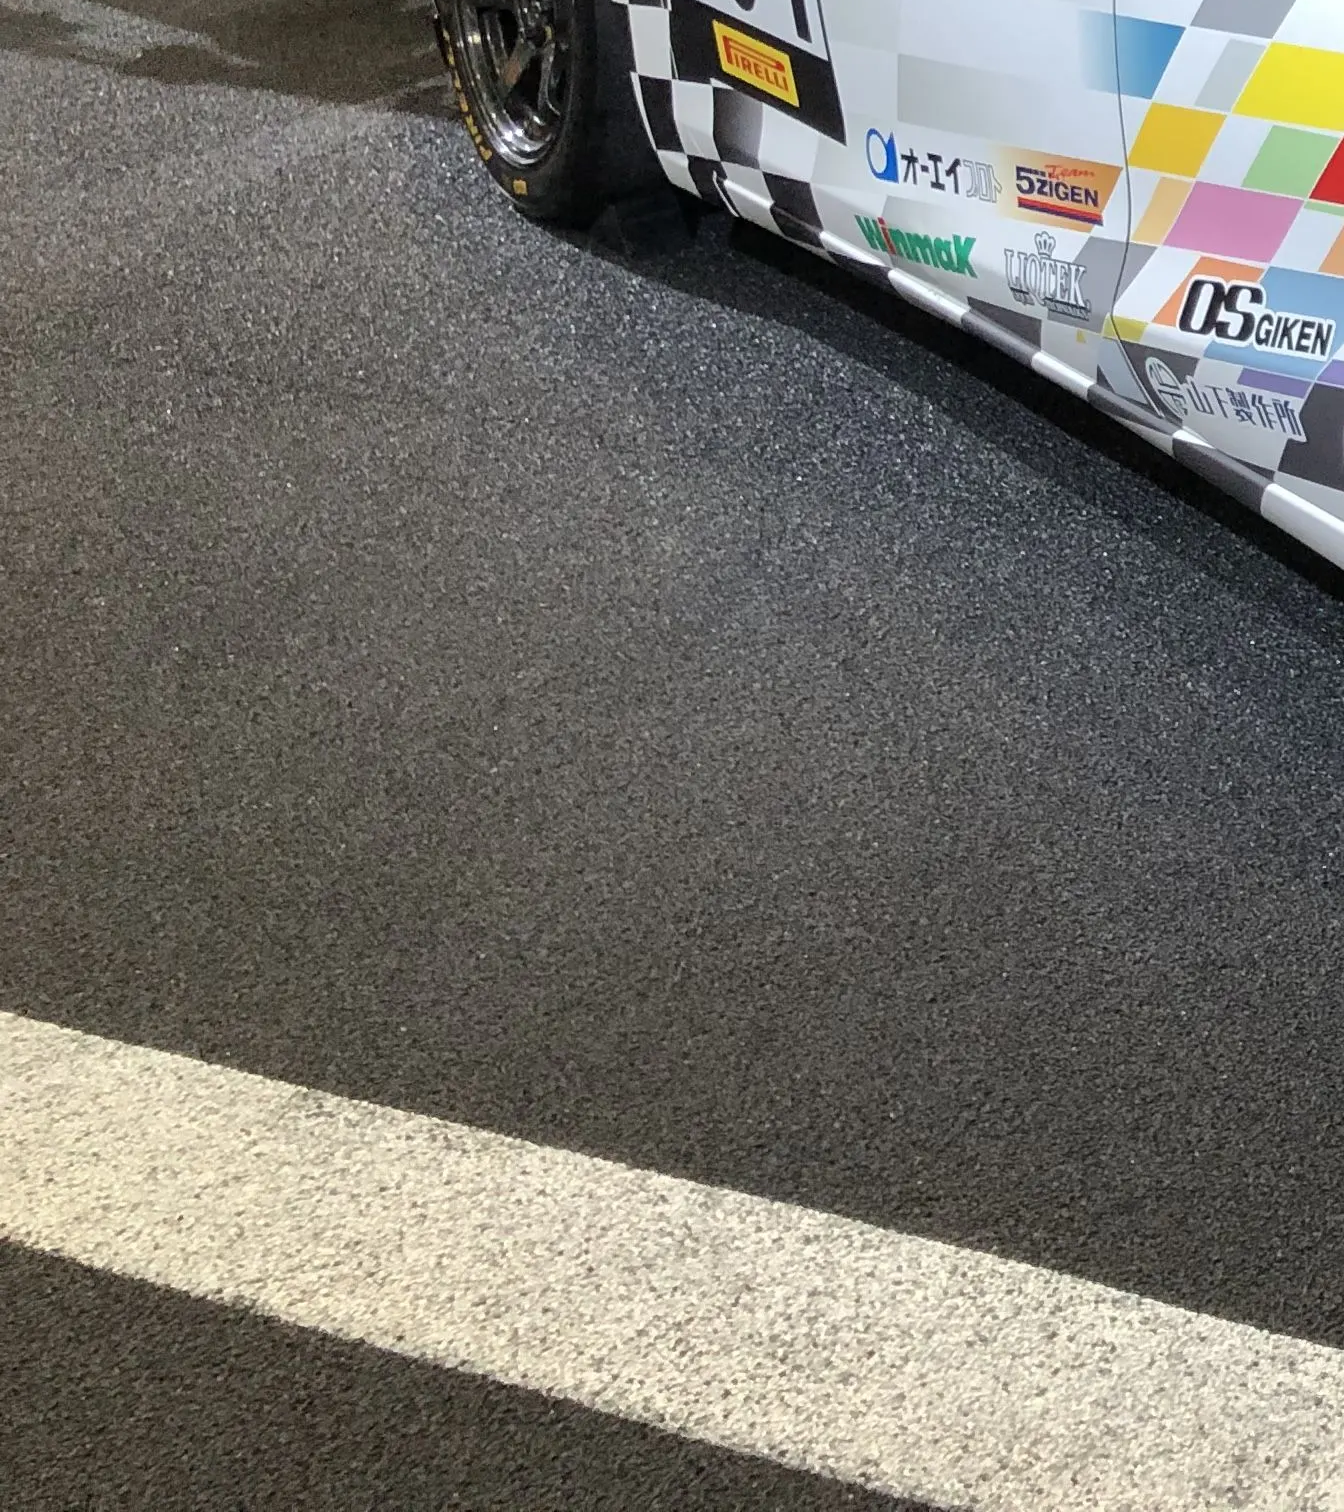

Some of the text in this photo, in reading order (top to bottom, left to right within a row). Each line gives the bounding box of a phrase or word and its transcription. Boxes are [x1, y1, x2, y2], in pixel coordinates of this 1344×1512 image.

[722, 34, 790, 92] PIRELLI
[1255, 313, 1334, 357] GIKEN
[1184, 375, 1303, 437] 山下製作所
